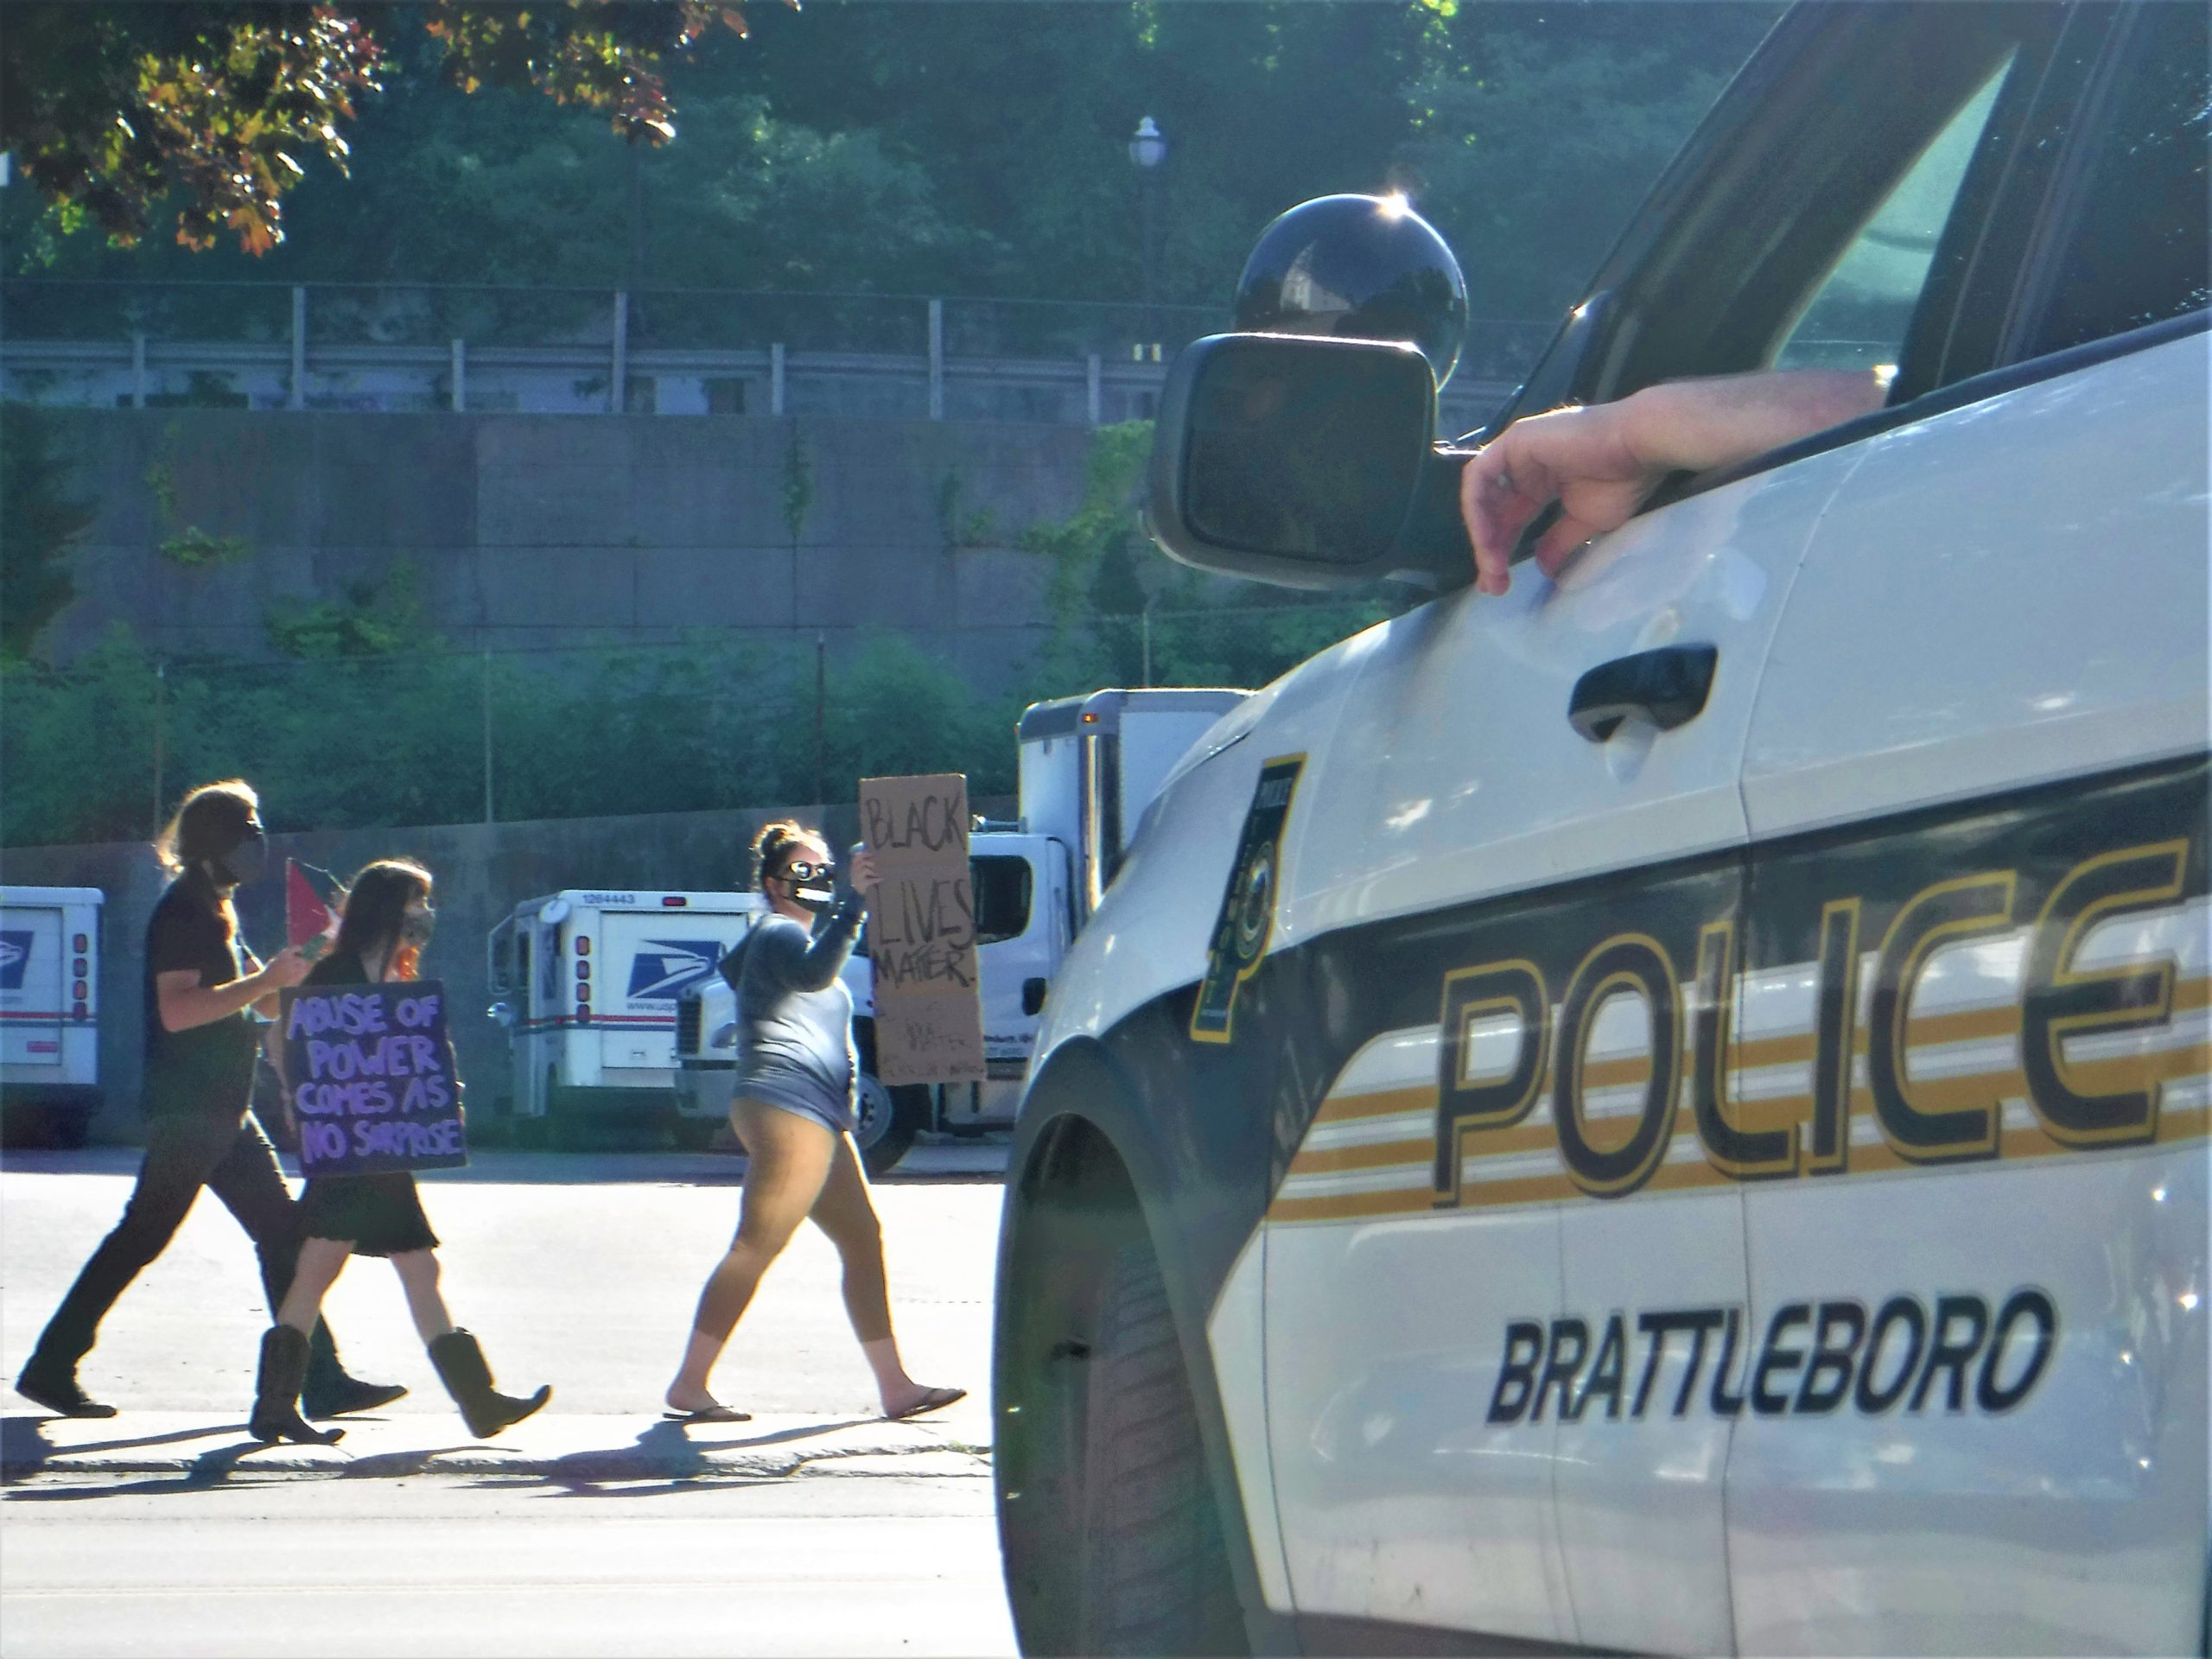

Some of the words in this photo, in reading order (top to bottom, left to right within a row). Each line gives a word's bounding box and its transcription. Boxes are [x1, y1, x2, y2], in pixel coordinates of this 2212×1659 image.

[866, 795, 966, 852] BLACK
[874, 879, 974, 950] LIVES
[287, 994, 388, 1039] ABUSE
[396, 995, 439, 1027] OF
[1432, 838, 2191, 1208] POLICE
[308, 1035, 441, 1080] POWER
[296, 1081, 395, 1116] COMES
[401, 1076, 448, 1113] AS
[302, 1122, 347, 1164] NO
[1486, 1285, 2060, 1425] BRATTLEBORO
